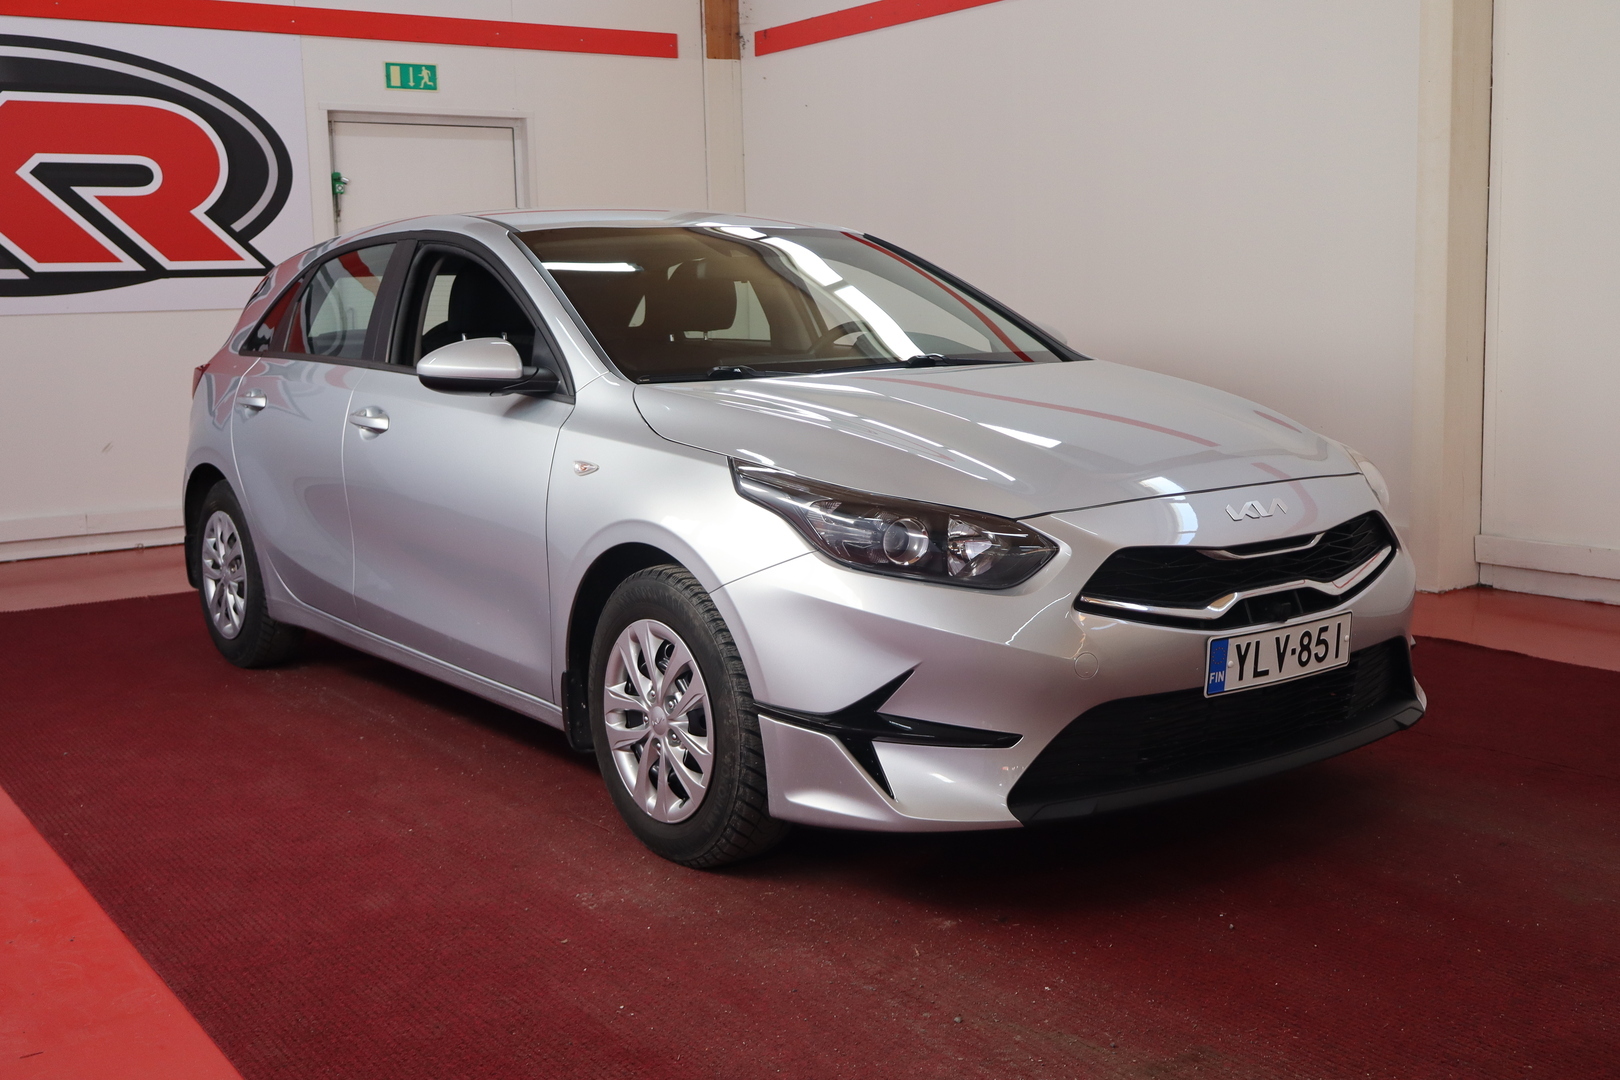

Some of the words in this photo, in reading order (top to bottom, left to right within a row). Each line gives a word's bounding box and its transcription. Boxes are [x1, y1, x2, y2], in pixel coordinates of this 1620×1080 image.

[1225, 498, 1288, 521] KIA
[1236, 622, 1341, 681] YLV-851
[1209, 670, 1225, 684] FIN
